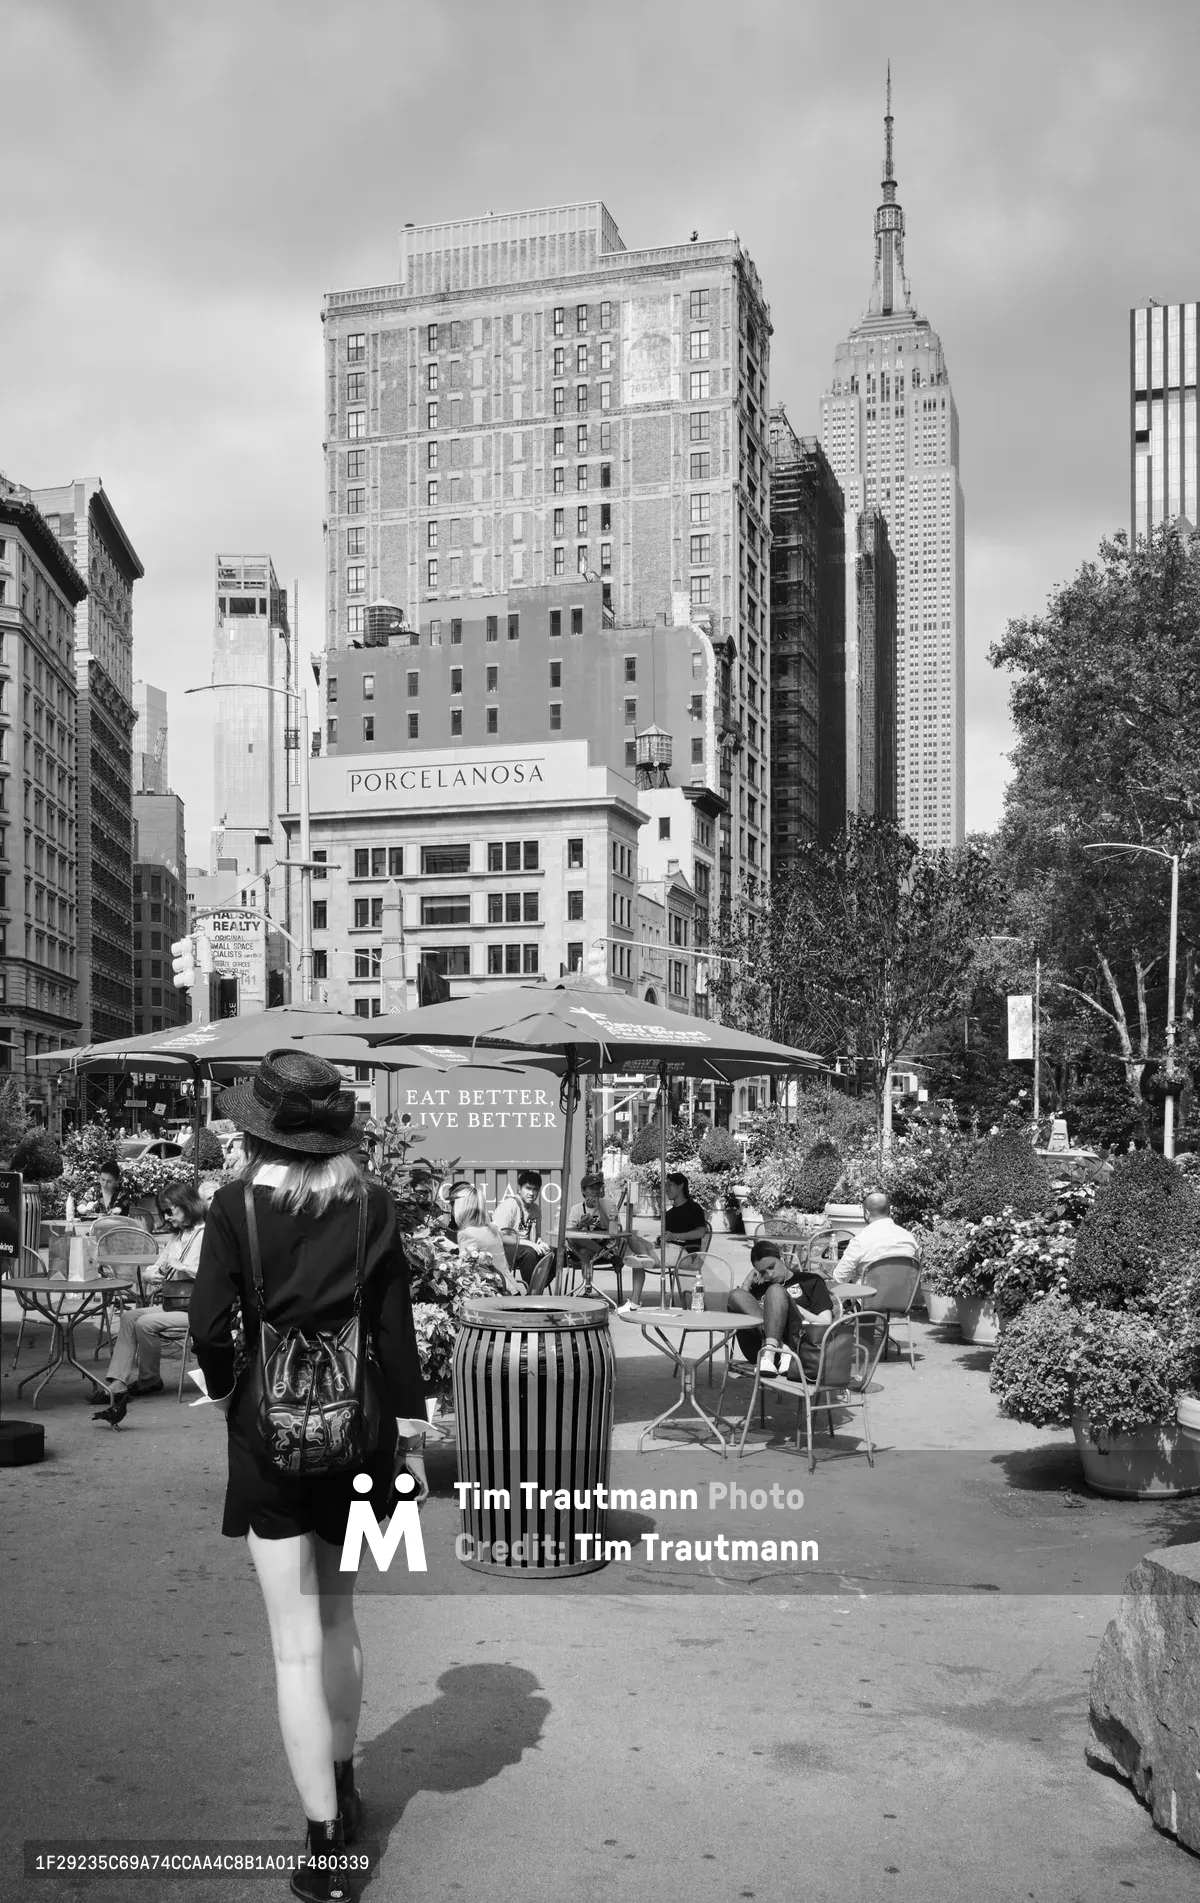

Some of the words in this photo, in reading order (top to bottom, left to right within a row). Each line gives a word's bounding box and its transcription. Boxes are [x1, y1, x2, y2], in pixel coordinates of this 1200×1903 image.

[351, 764, 544, 793] PORCELANOSA
[213, 921, 261, 931] REALTY
[406, 1089, 450, 1105] EAT
[458, 1089, 555, 1107] BETTER,
[468, 1112, 557, 1128] BETTER
